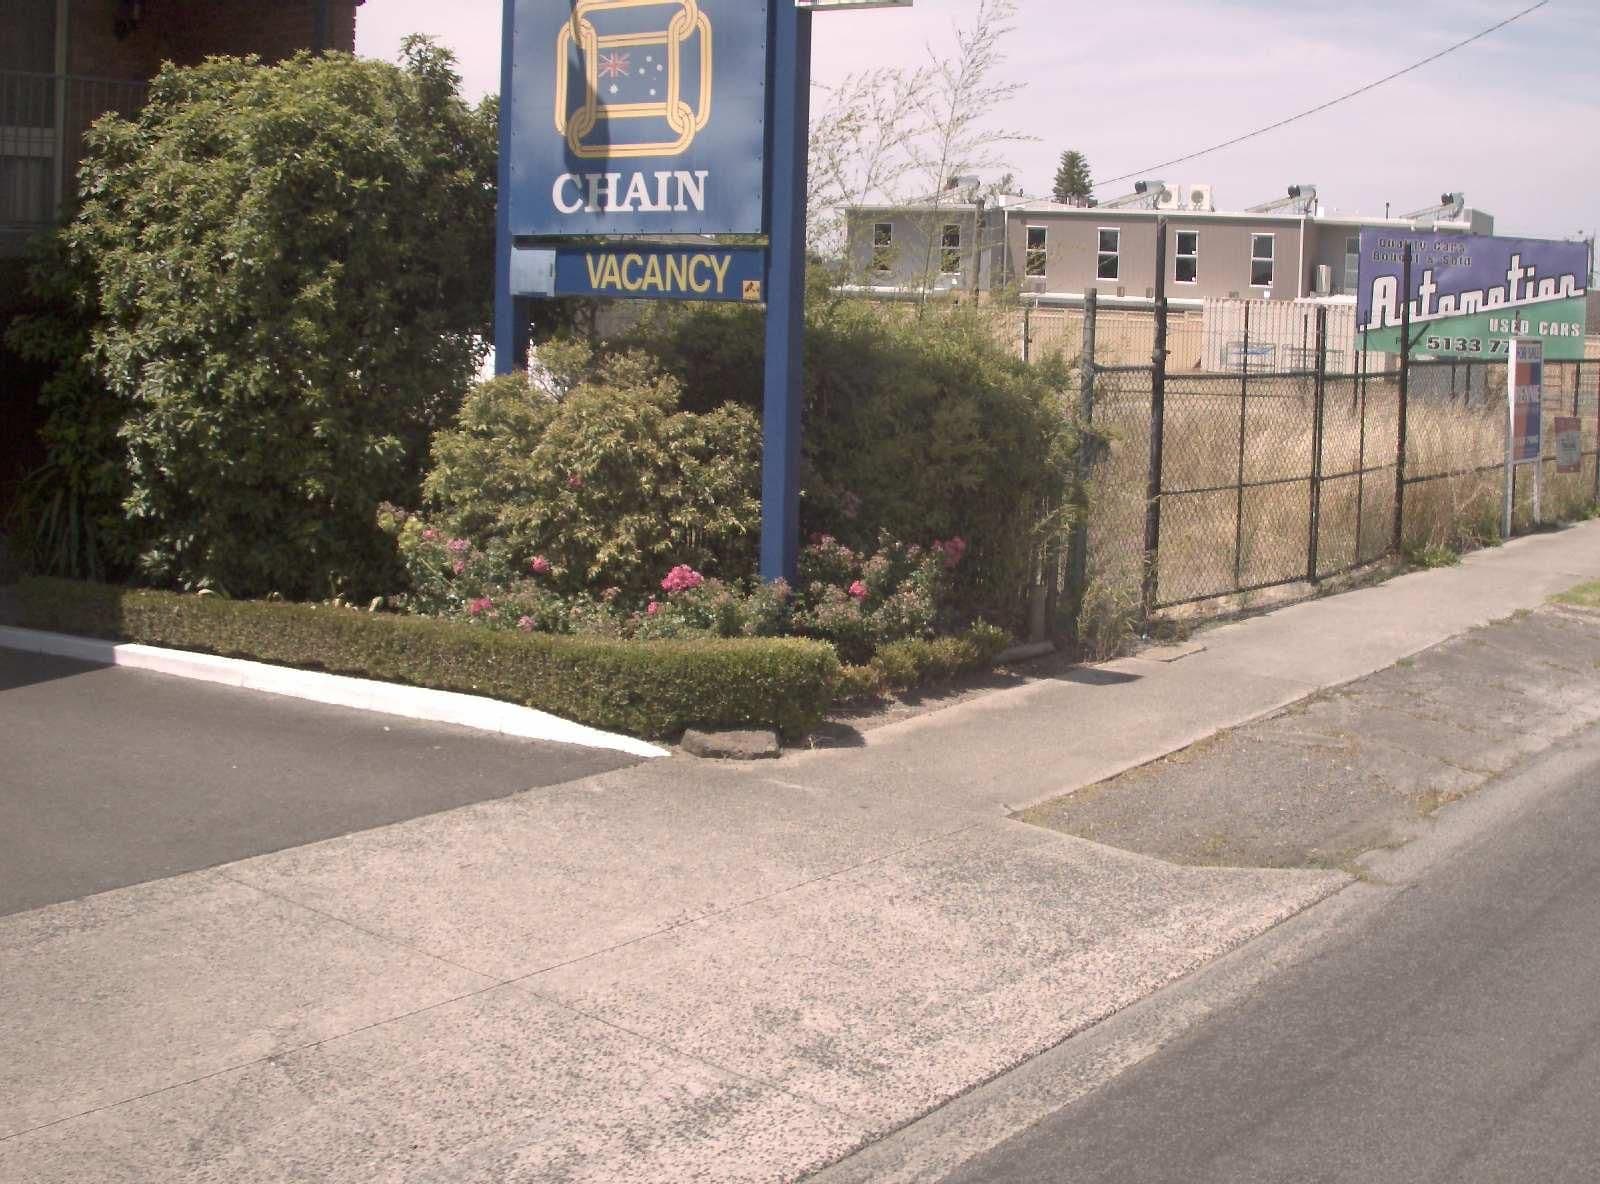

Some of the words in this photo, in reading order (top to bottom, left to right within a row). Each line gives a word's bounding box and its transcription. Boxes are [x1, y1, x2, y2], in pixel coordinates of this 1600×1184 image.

[552, 170, 709, 214] CHAIN
[586, 252, 731, 293] VACANCY
[1489, 318, 1529, 335] USED
[1538, 320, 1582, 337] CARS
[1427, 336, 1481, 353] 5133
